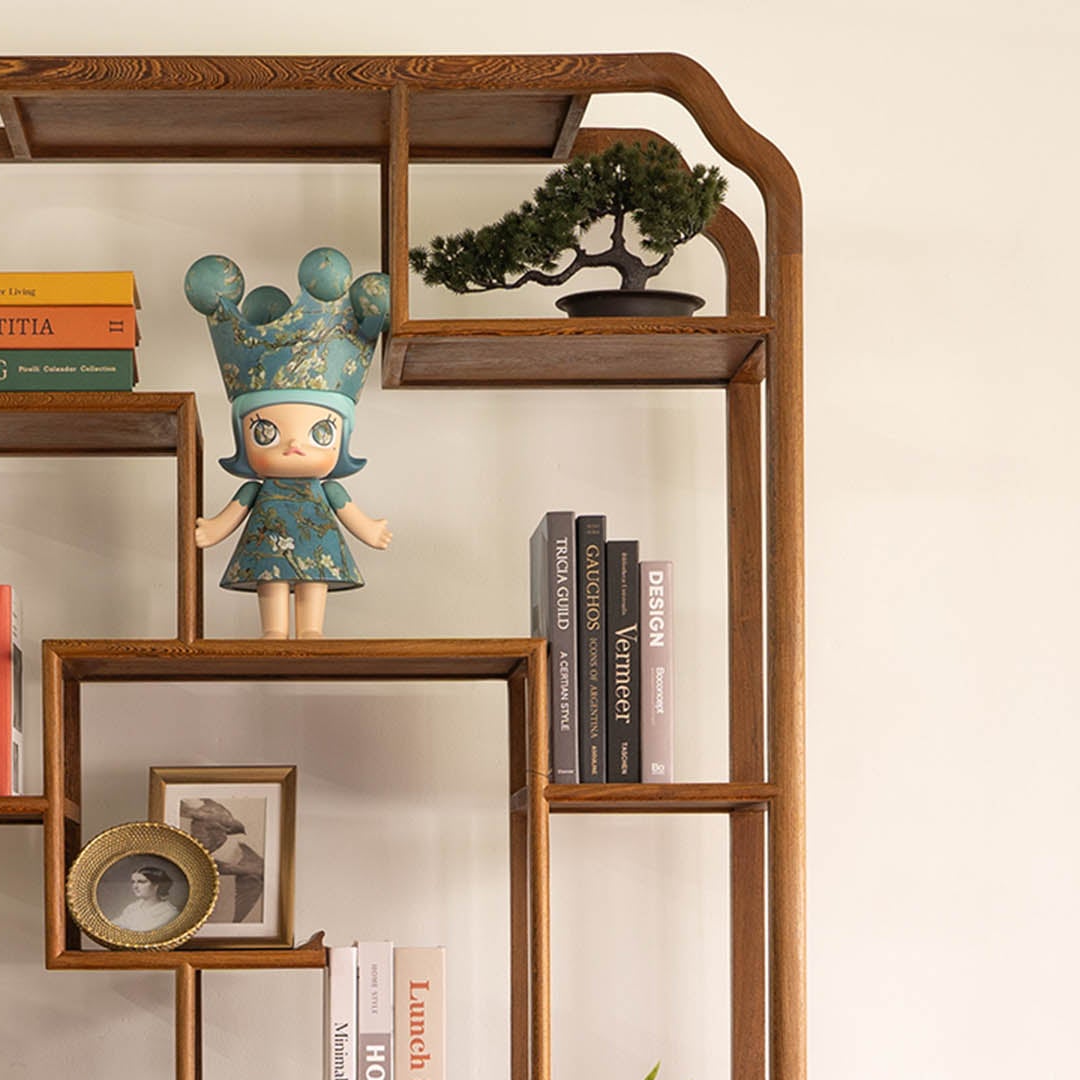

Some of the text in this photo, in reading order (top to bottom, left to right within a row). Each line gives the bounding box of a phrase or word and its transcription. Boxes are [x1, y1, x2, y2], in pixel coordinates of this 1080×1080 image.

[8, 288, 37, 297] Living
[556, 537, 570, 631] TRICIA GUILD
[586, 544, 601, 631] GAUCHOS
[648, 571, 664, 647] DESIGN
[559, 651, 567, 660] A
[589, 637, 599, 739] ICONS OF ARGENTINA
[614, 622, 638, 725] Vermeer
[560, 702, 570, 731] STYLE
[620, 742, 628, 775] TASCHEN
[409, 980, 430, 1070] Lunch
